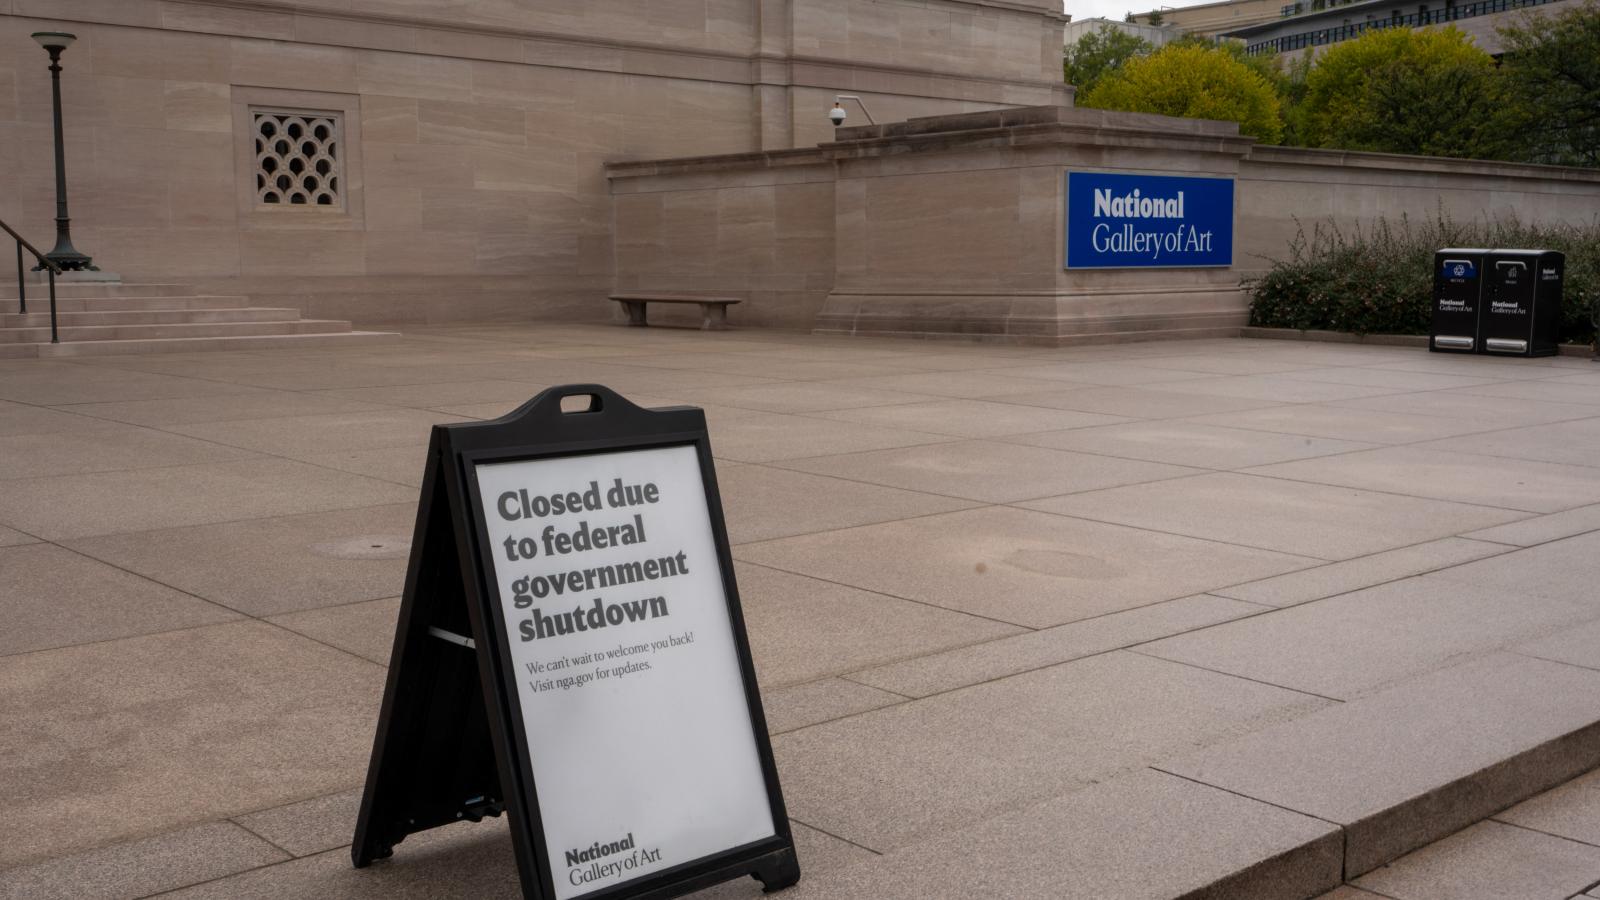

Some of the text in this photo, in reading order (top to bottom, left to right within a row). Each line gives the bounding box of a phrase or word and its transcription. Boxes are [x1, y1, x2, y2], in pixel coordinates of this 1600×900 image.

[1093, 188, 1184, 218] National
[1092, 223, 1213, 259] Gallery of Art
[497, 478, 660, 521] Closed due
[502, 514, 647, 562] to federal
[511, 550, 689, 609] government
[518, 595, 669, 642] shutdown
[525, 631, 695, 675] We can't wait to welcome you back!
[529, 660, 652, 693] Visit nga.gov for updates.
[564, 832, 635, 868] National
[569, 848, 663, 886] Gallery of Art
